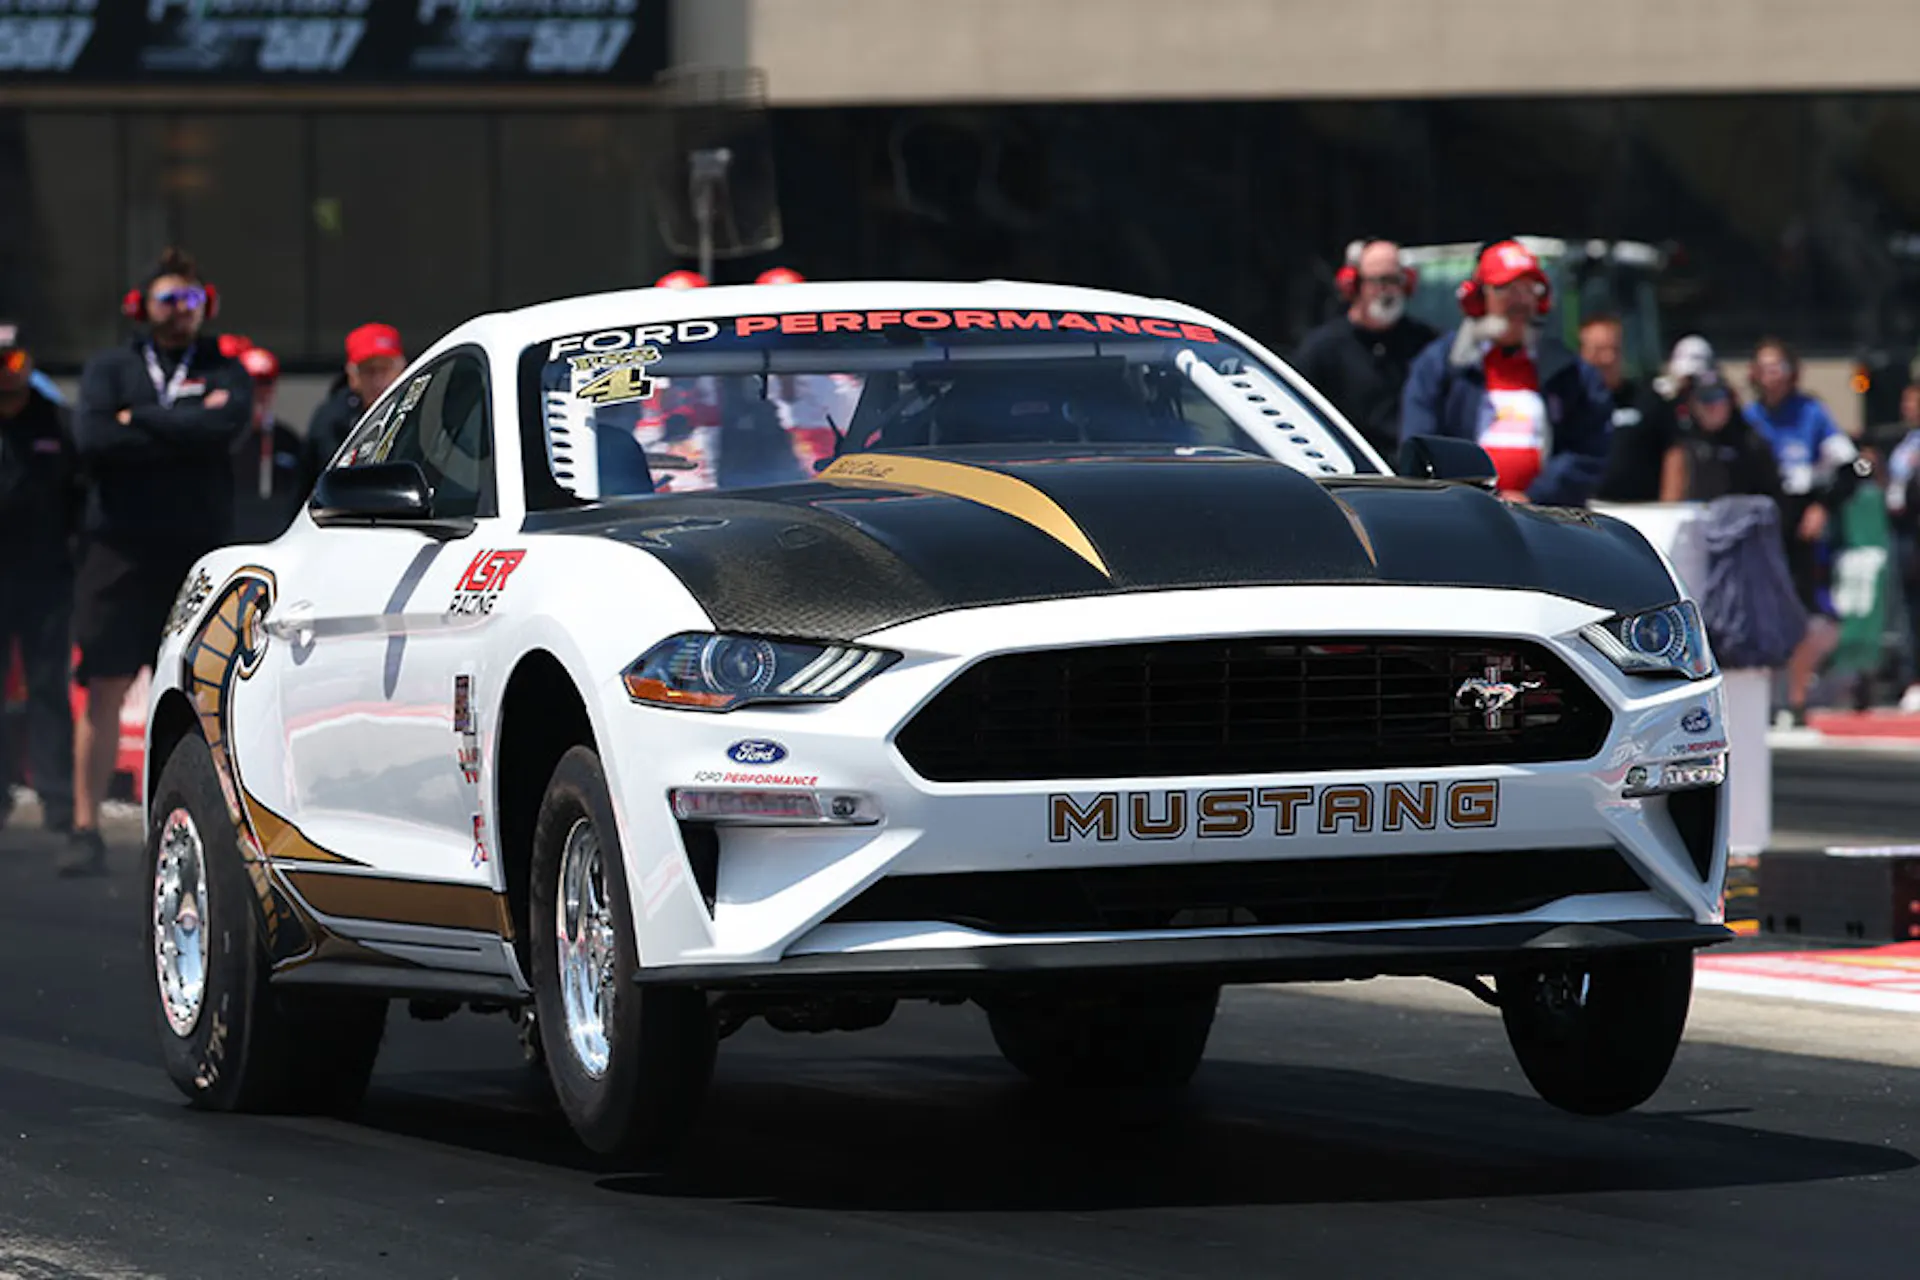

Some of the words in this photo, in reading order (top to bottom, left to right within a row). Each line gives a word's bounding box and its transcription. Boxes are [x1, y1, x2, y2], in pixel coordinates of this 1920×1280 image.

[549, 320, 719, 361] FORD
[735, 310, 1219, 343] PERFORMANCE
[576, 367, 652, 403] 4
[454, 548, 527, 592] KSR
[448, 594, 497, 616] RACING
[733, 740, 777, 763] Ford
[693, 771, 722, 783] FORD
[723, 772, 819, 786] PERFORMANCE
[1049, 779, 1499, 842] MUSTANG
